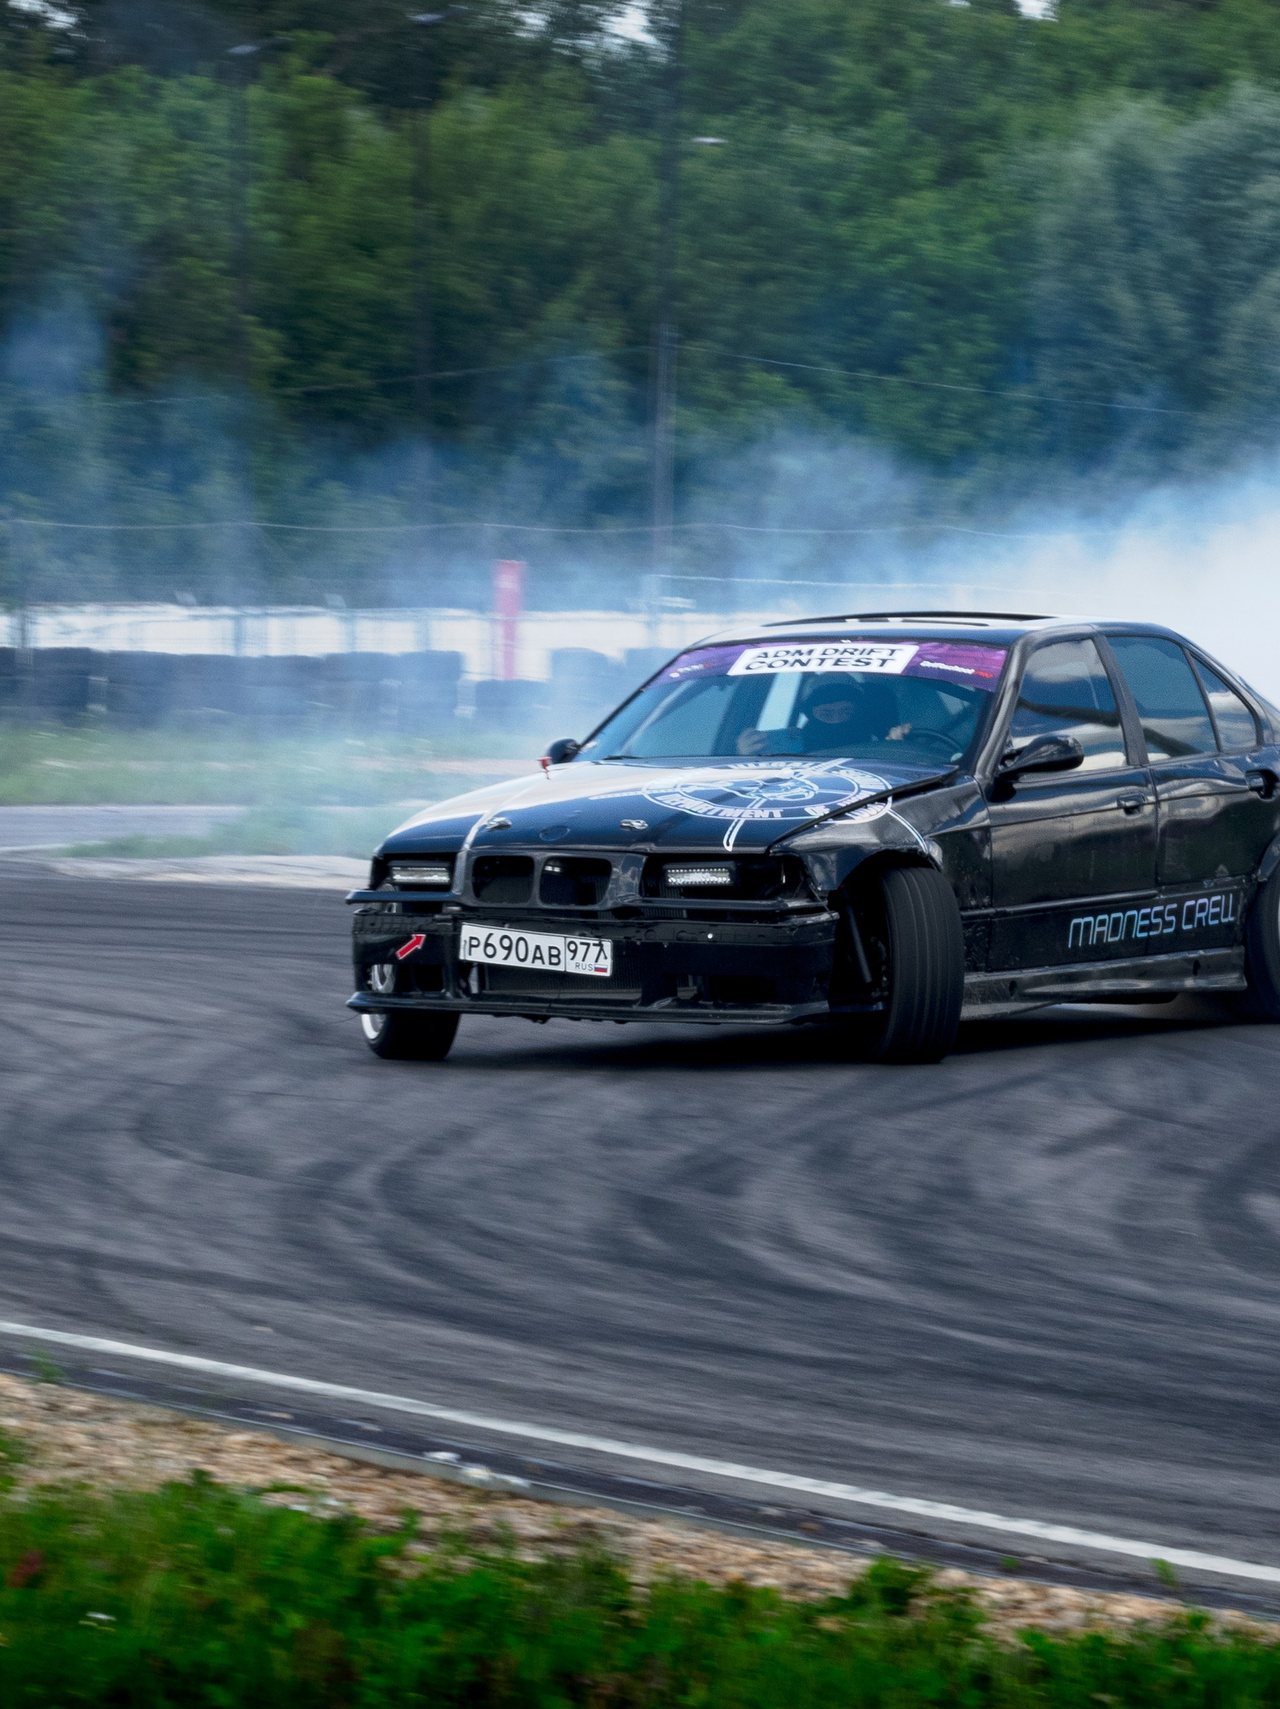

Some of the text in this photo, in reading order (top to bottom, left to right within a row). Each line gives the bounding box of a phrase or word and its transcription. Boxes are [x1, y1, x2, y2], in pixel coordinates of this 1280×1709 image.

[755, 647, 904, 658] ADM DRIFT
[745, 658, 896, 670] CONTEST
[1068, 903, 1177, 948] MADNESS
[574, 961, 593, 972] RUS
